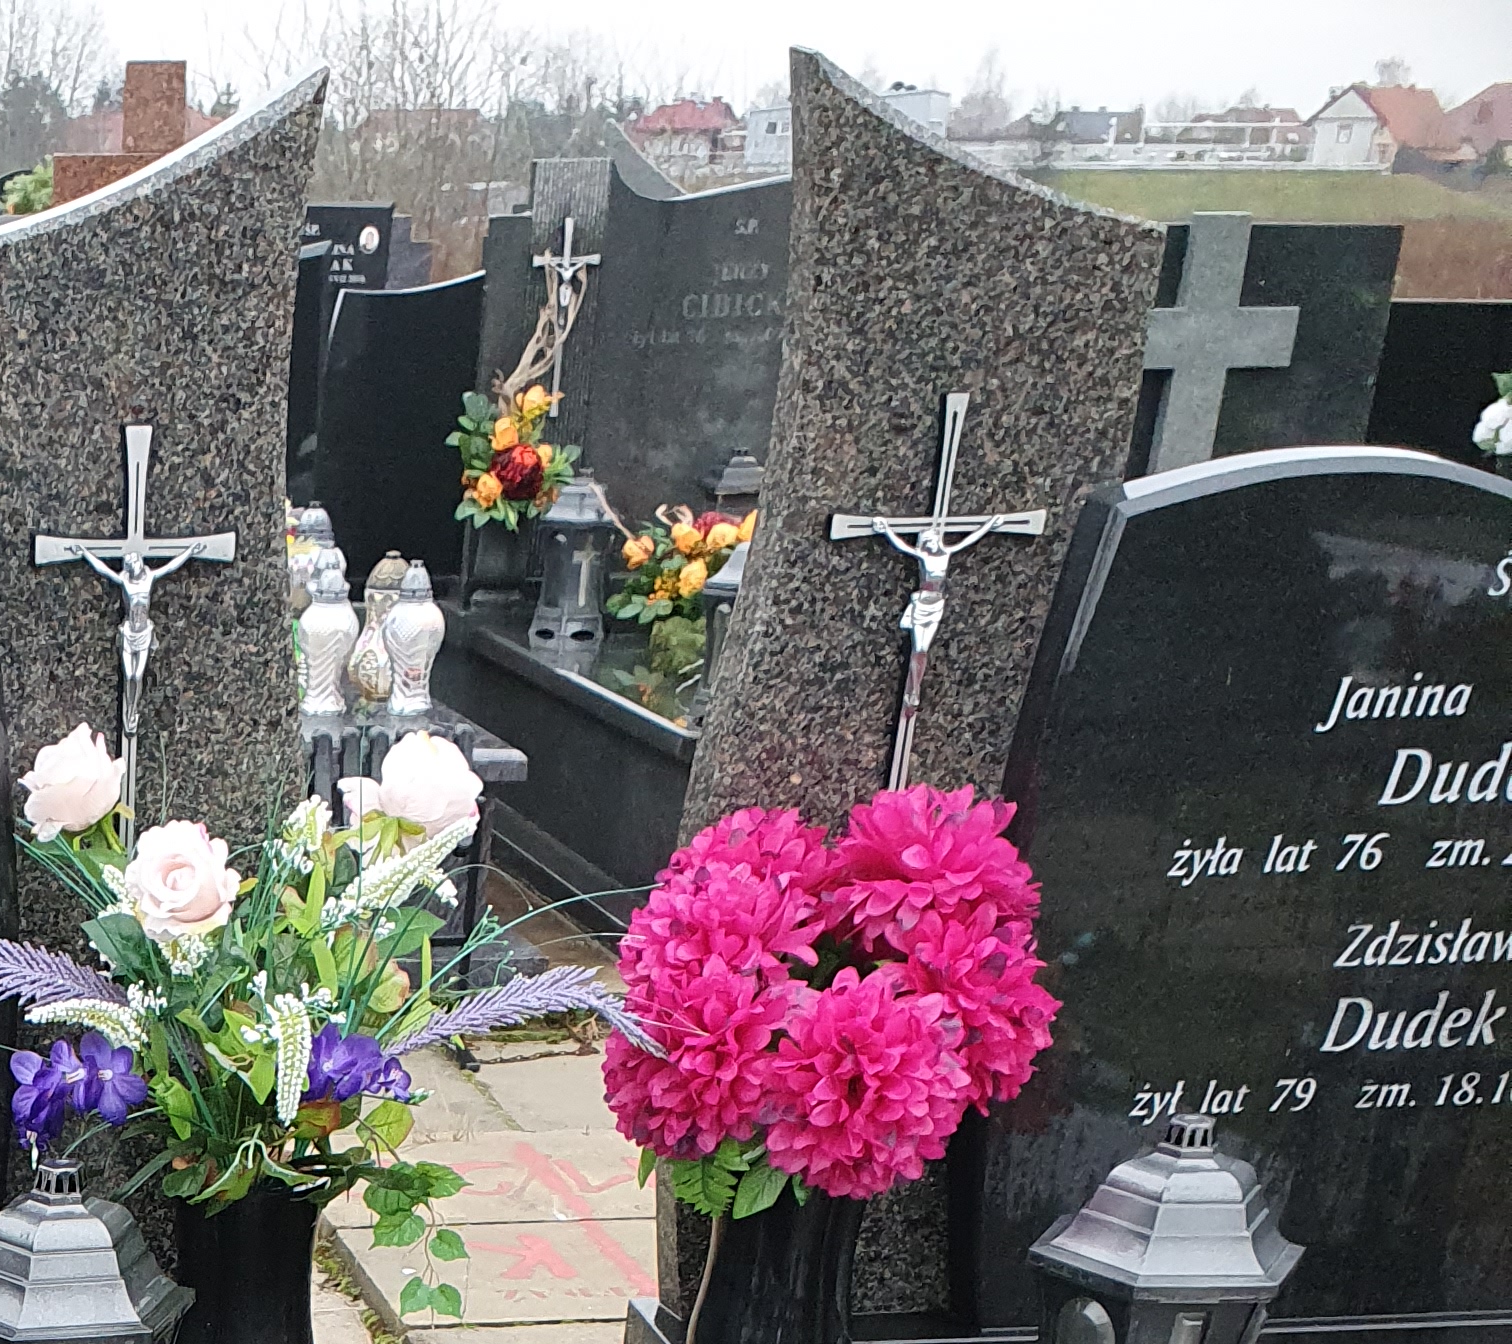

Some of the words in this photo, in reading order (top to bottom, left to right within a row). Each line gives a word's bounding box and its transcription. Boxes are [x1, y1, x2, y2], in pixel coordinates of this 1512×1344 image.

[1315, 671, 1474, 732] Janina
[1166, 836, 1241, 886] żyła
[1263, 833, 1318, 874] lat
[1335, 832, 1390, 871] 76
[1425, 838, 1491, 868] zm.
[1319, 989, 1508, 1052] Dudek
[1128, 1079, 1186, 1126] żył
[1199, 1079, 1251, 1115] lat
[1268, 1077, 1317, 1113] 79
[1354, 1082, 1417, 1110] zm.
[1434, 1070, 1512, 1107] 18.1
